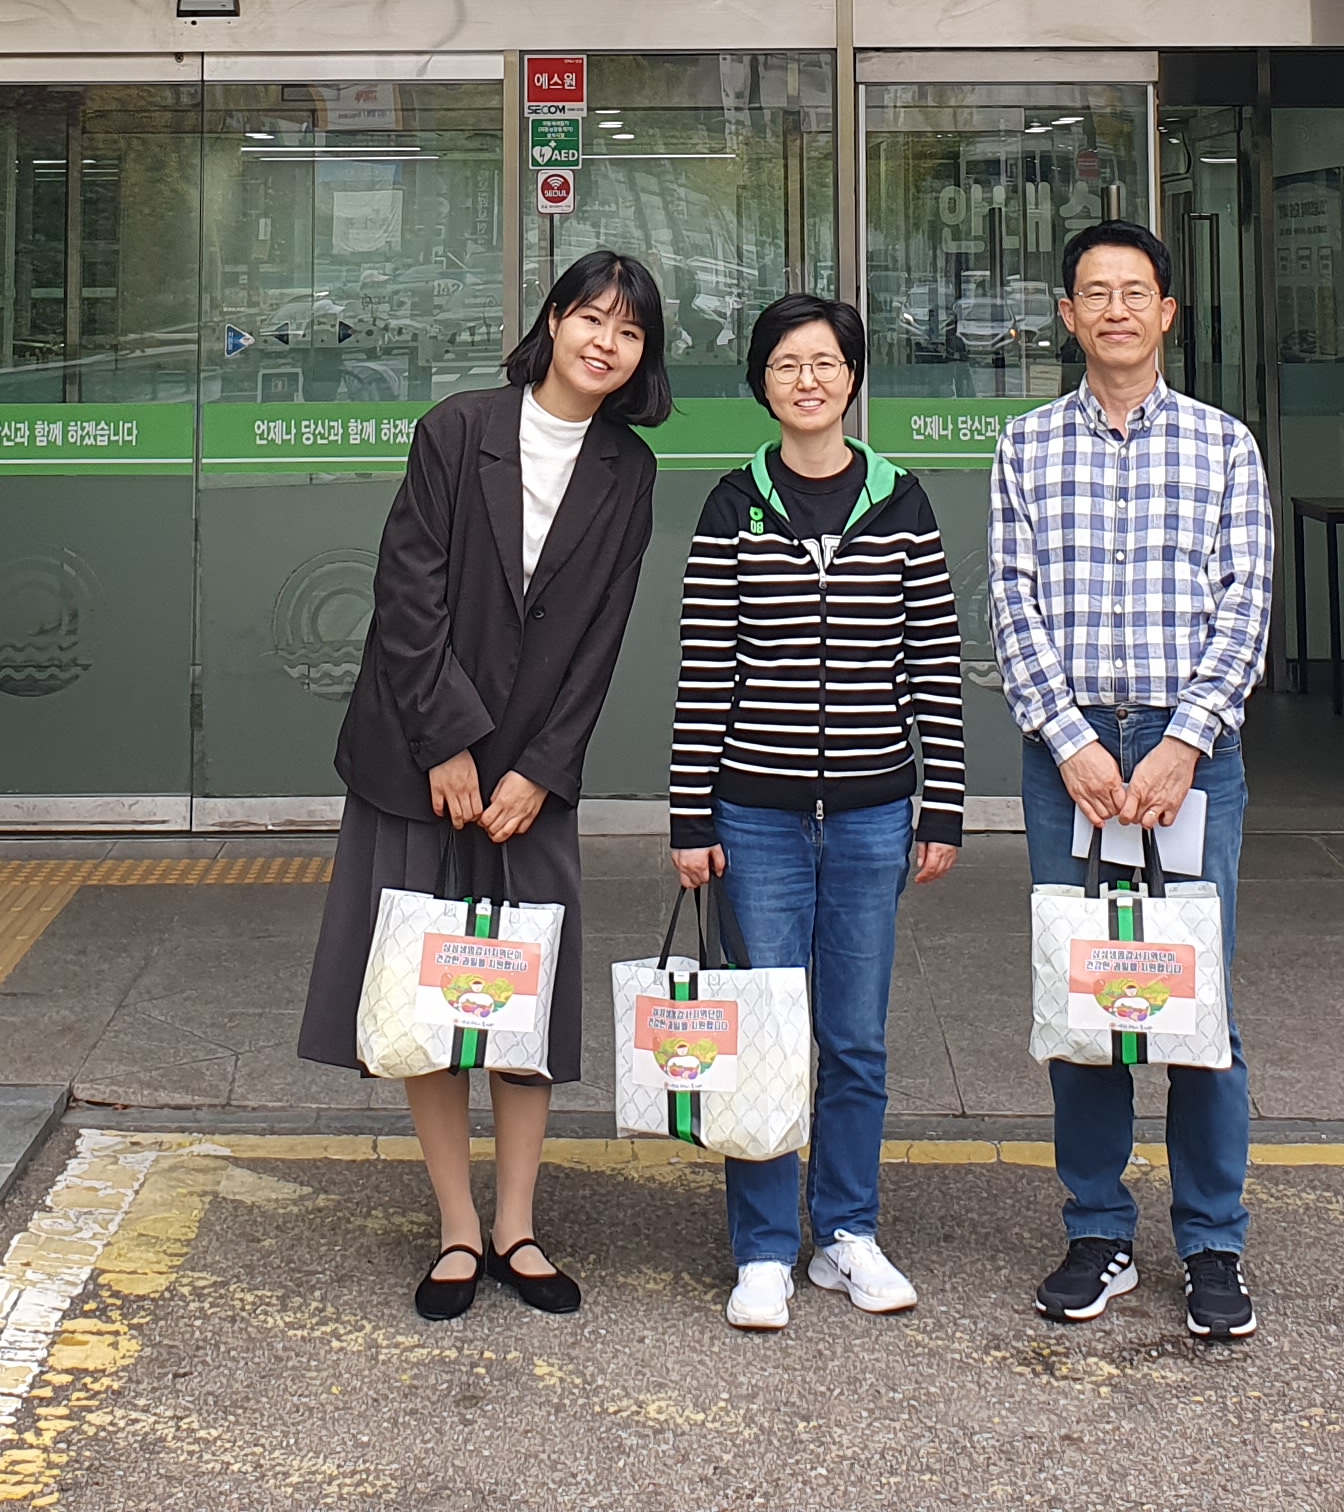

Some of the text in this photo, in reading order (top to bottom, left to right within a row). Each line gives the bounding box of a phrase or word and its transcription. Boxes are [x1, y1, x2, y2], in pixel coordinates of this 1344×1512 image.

[534, 72, 577, 90] 에스원
[527, 104, 566, 115] SECOM
[551, 149, 578, 161] AED
[34, 420, 63, 447] 함께
[67, 419, 138, 447] 하겠습니다
[254, 418, 296, 445] 언제나
[301, 418, 343, 445] 당신과
[348, 418, 376, 445] 함께
[910, 414, 1000, 441] 언제나 당신과
